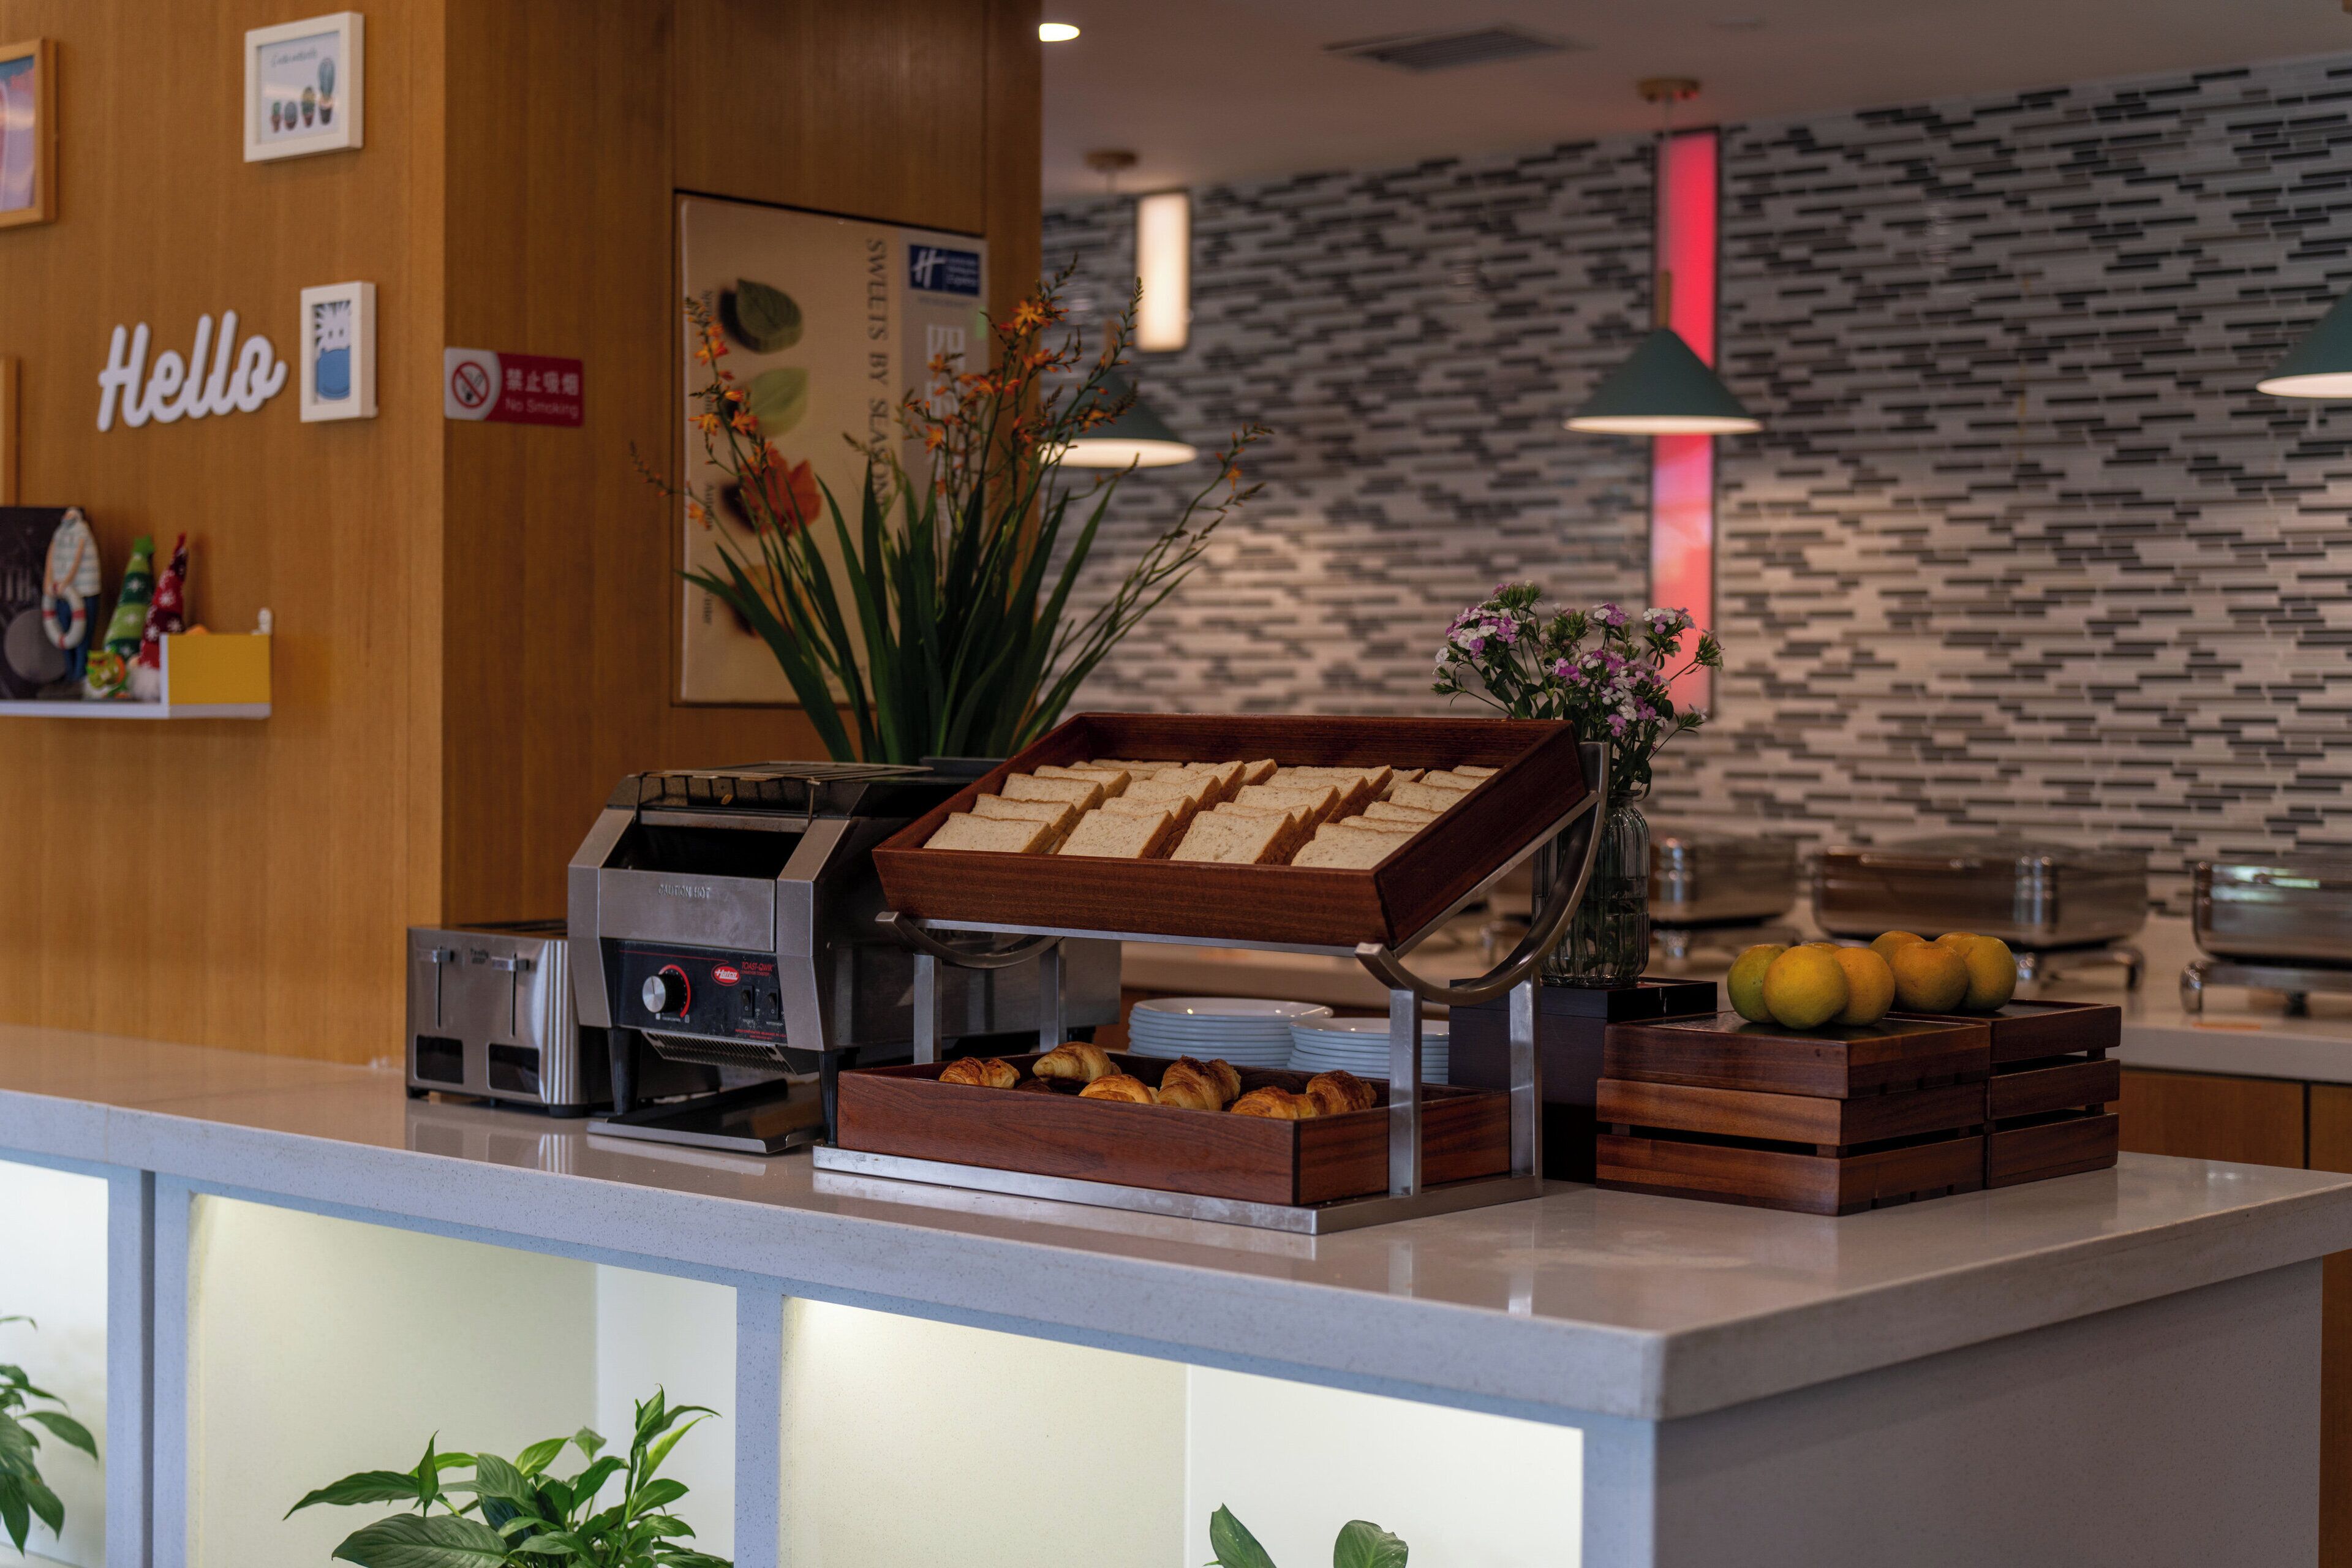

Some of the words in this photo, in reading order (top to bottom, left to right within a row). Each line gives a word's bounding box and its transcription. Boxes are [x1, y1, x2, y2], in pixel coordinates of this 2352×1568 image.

[97, 310, 288, 431] Hello
[867, 352, 891, 385] BY
[505, 397, 524, 413] No
[526, 398, 579, 420] Smoking
[657, 884, 692, 897] CAUTION
[693, 886, 710, 899] HOT
[715, 969, 737, 978] Hatco
